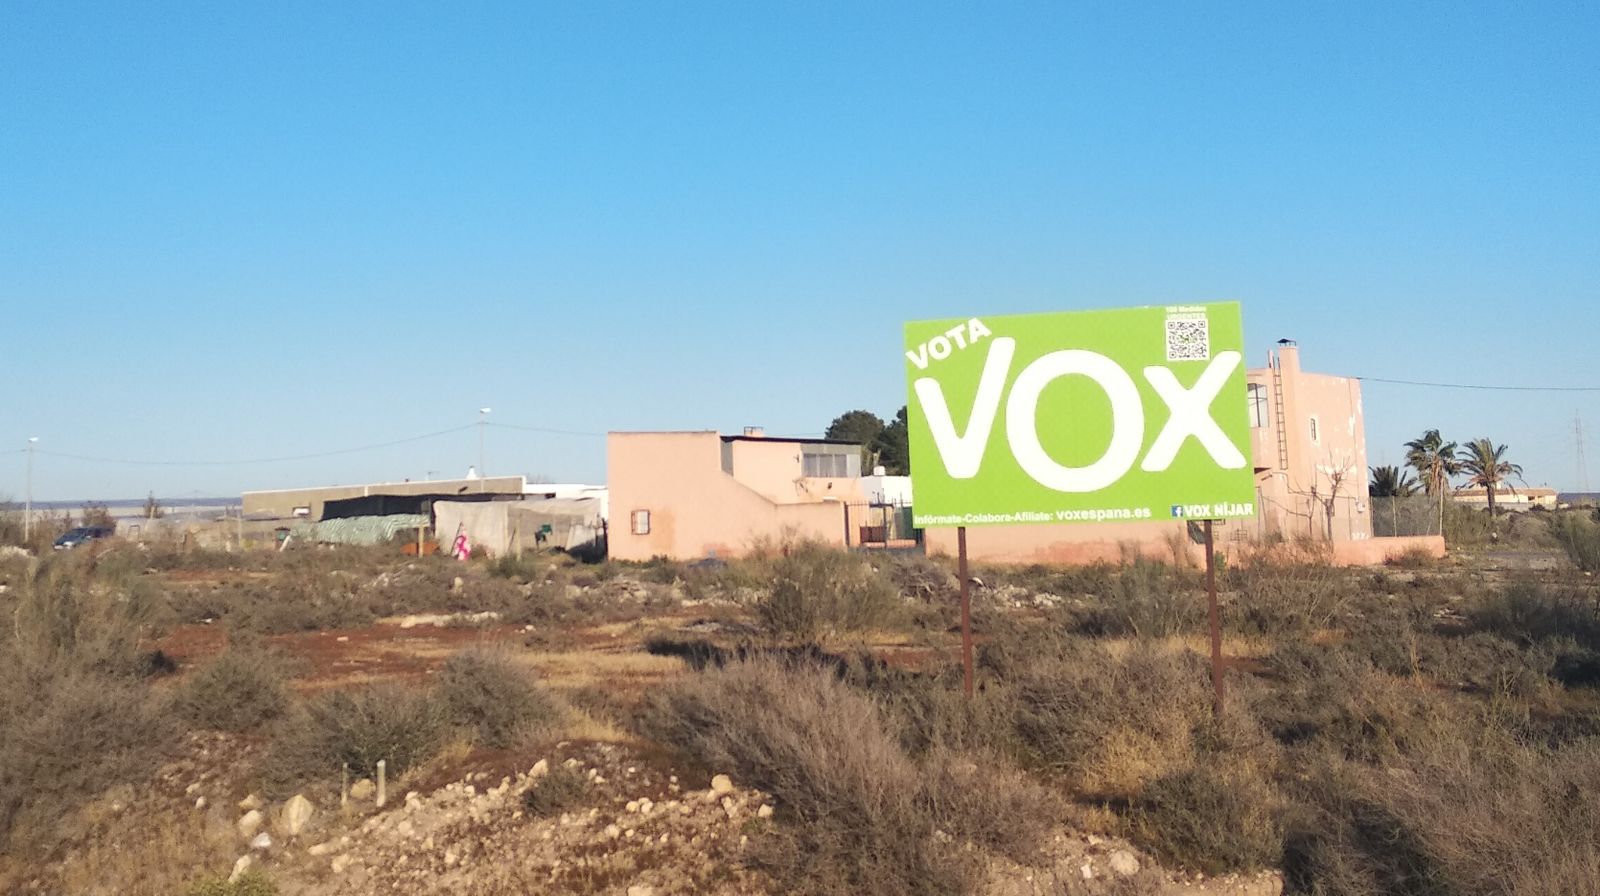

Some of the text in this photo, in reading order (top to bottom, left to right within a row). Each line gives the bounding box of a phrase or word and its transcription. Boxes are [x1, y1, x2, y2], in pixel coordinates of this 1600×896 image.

[905, 317, 992, 370] VOTA
[913, 336, 1248, 493] VOX
[1056, 507, 1151, 521] voxespana.es
[1184, 504, 1211, 517] VOX
[1214, 501, 1254, 517] NÍJAR
